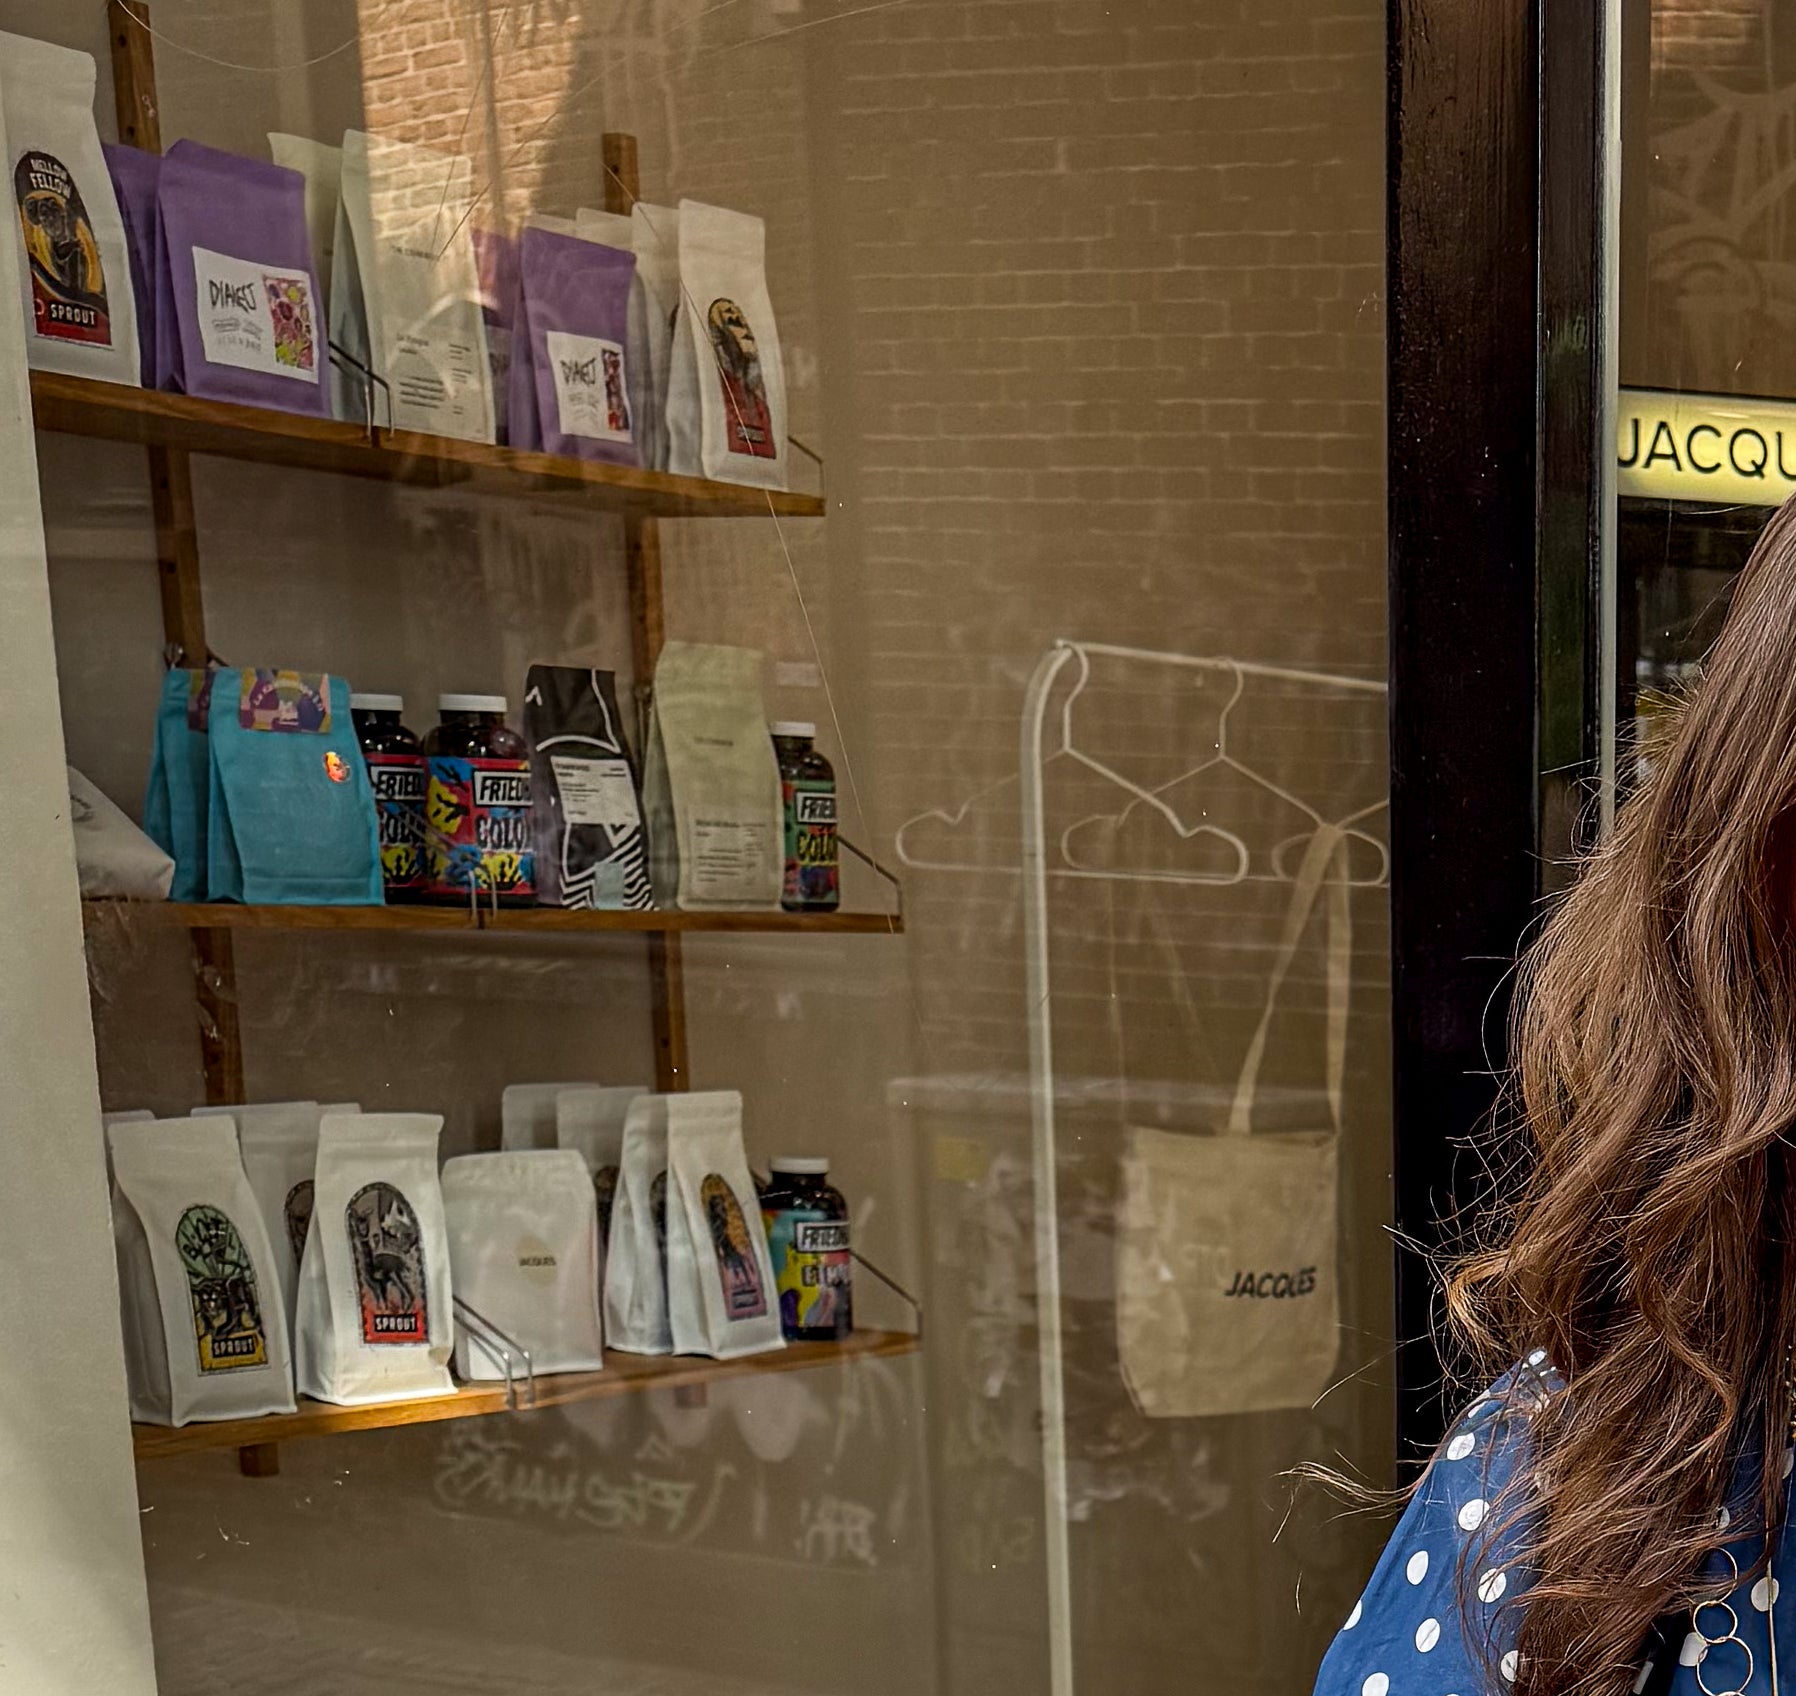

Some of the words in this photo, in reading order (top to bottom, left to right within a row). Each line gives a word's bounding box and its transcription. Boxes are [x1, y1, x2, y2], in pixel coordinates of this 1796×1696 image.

[30, 172, 71, 199] FELLOW
[50, 303, 96, 326] SPROUT
[376, 1315, 416, 1331] SPROUT
[213, 1338, 253, 1356] SPROUT
